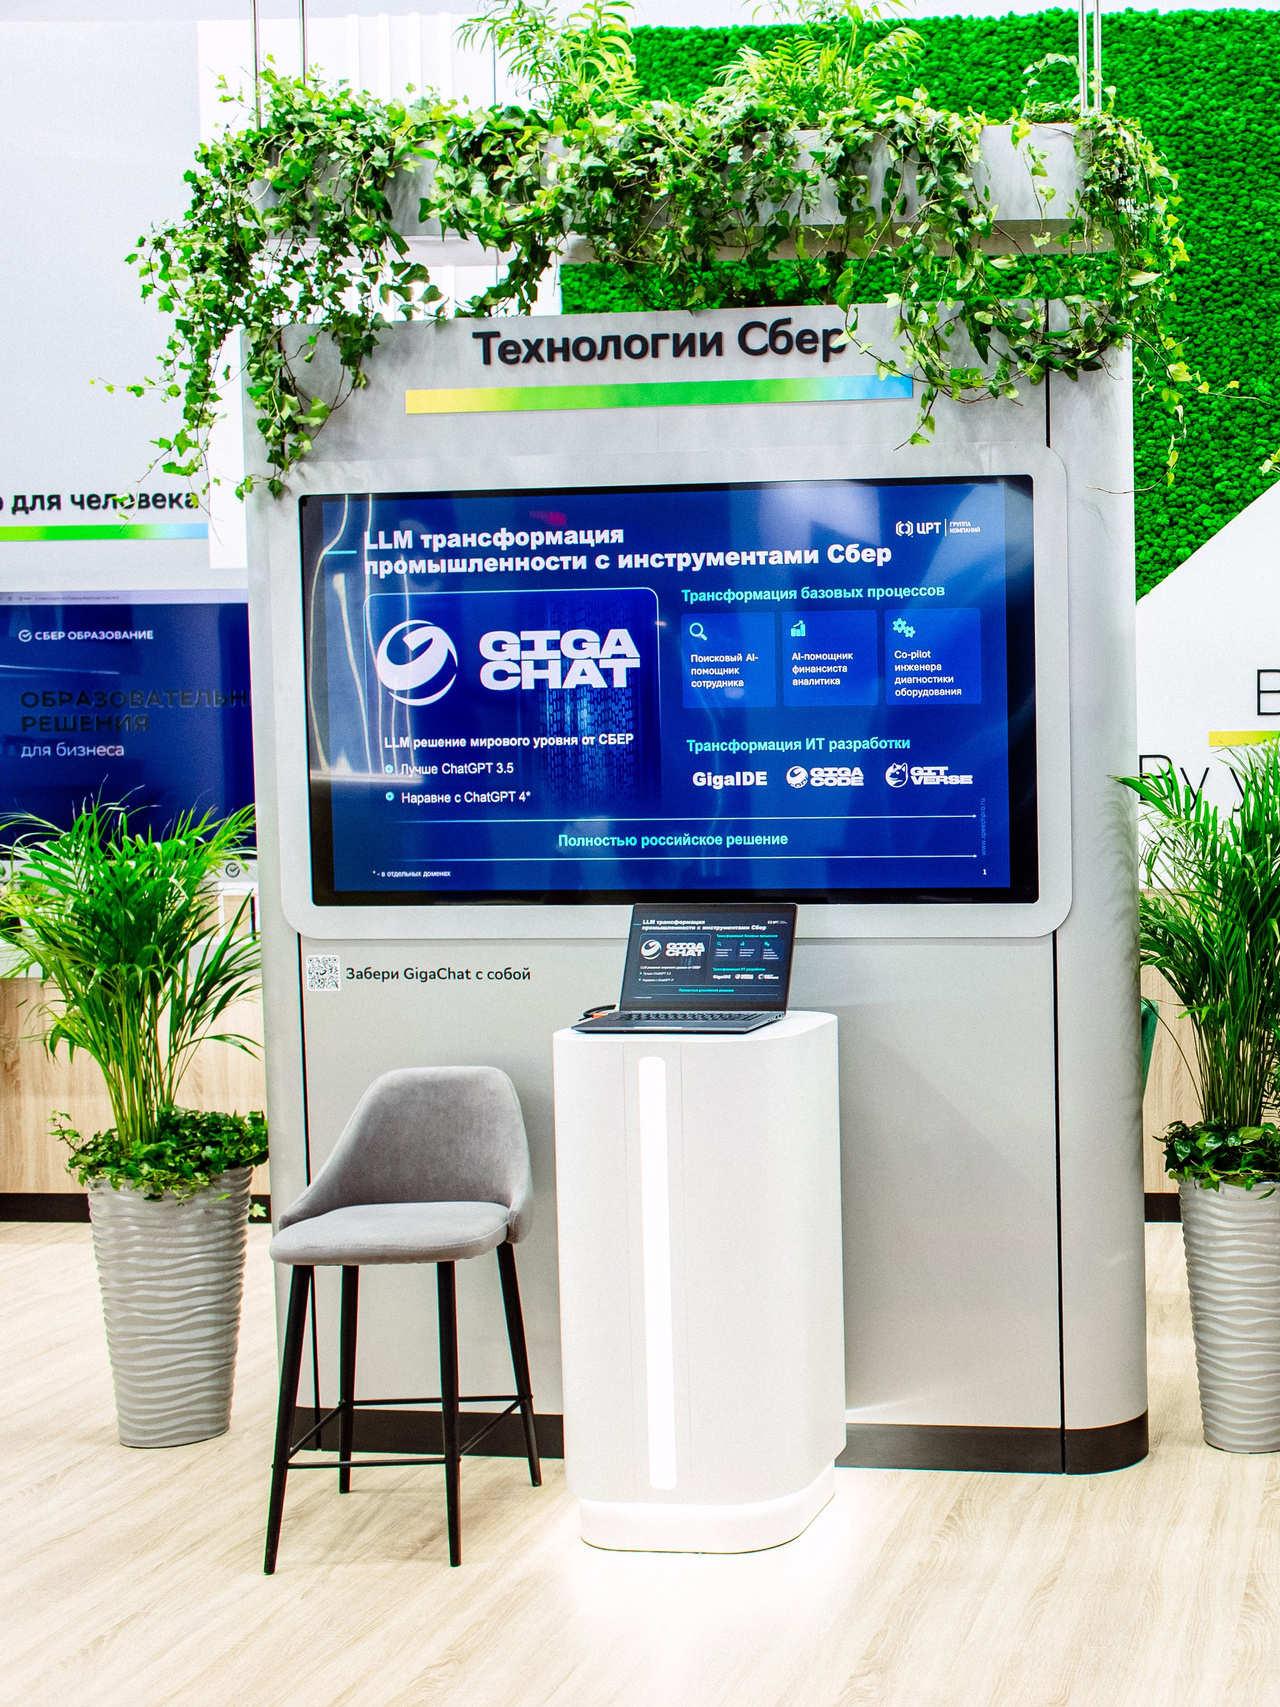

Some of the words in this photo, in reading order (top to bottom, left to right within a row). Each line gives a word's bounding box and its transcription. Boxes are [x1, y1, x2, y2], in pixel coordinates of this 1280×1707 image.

[472, 328, 724, 365] Технологии
[737, 317, 847, 364] Сбер
[11, 492, 62, 515] для
[70, 490, 200, 512] человека
[916, 522, 942, 535] ЦРТ
[364, 530, 413, 551] LLM
[420, 527, 624, 553] трансформация
[364, 552, 587, 578] промышленности
[595, 554, 610, 569] с
[618, 548, 819, 572] инструментами
[827, 543, 892, 567] Сбер
[681, 588, 798, 605] Трансформация
[800, 585, 864, 600] базовых
[867, 584, 946, 602] процессов
[35, 630, 65, 641] СБЕР
[67, 629, 154, 641] ОБРАЗОВАНИЕ
[479, 628, 640, 661] GIGA
[690, 652, 743, 664] Поисковый
[792, 651, 854, 663] AI-помощник
[894, 649, 932, 661] Co-pilot
[690, 665, 740, 677] помощник
[792, 663, 848, 676] финансиста
[894, 662, 942, 673] инженера
[479, 658, 641, 691] CHAT
[894, 674, 954, 686] диагностики
[690, 677, 745, 689] сотрудника
[792, 676, 841, 687] аналитика
[894, 686, 962, 699] оборудования
[20, 690, 251, 709] ОБРАЗОВАТЕЛЬН
[21, 714, 150, 733] РЕШЕНИЯ
[384, 736, 410, 748] LLM
[413, 736, 467, 750] решение
[469, 735, 530, 749] мирового
[533, 734, 578, 750] уровня
[581, 736, 595, 746] от
[598, 733, 634, 746] СБЕР
[687, 739, 802, 755] Трансформация
[805, 737, 825, 750] ИТ
[828, 736, 911, 753] разработки
[20, 745, 51, 758] для
[56, 741, 125, 758] бизнеса
[401, 763, 438, 776] Лучше
[441, 762, 493, 775] ChatGPT
[496, 762, 514, 774] 3.5
[809, 767, 864, 778] GIGA
[910, 766, 949, 776] GIT
[809, 775, 865, 787] CODE
[911, 774, 973, 786] VERSE
[401, 791, 451, 804] Наравне
[464, 790, 516, 803] ChatGPT
[558, 834, 637, 848] Полностью
[641, 833, 722, 849] российское
[726, 833, 788, 848] решение
[346, 967, 400, 983] Забери
[403, 967, 471, 983] GigaChat
[475, 970, 483, 980] с
[487, 967, 531, 980] собой
